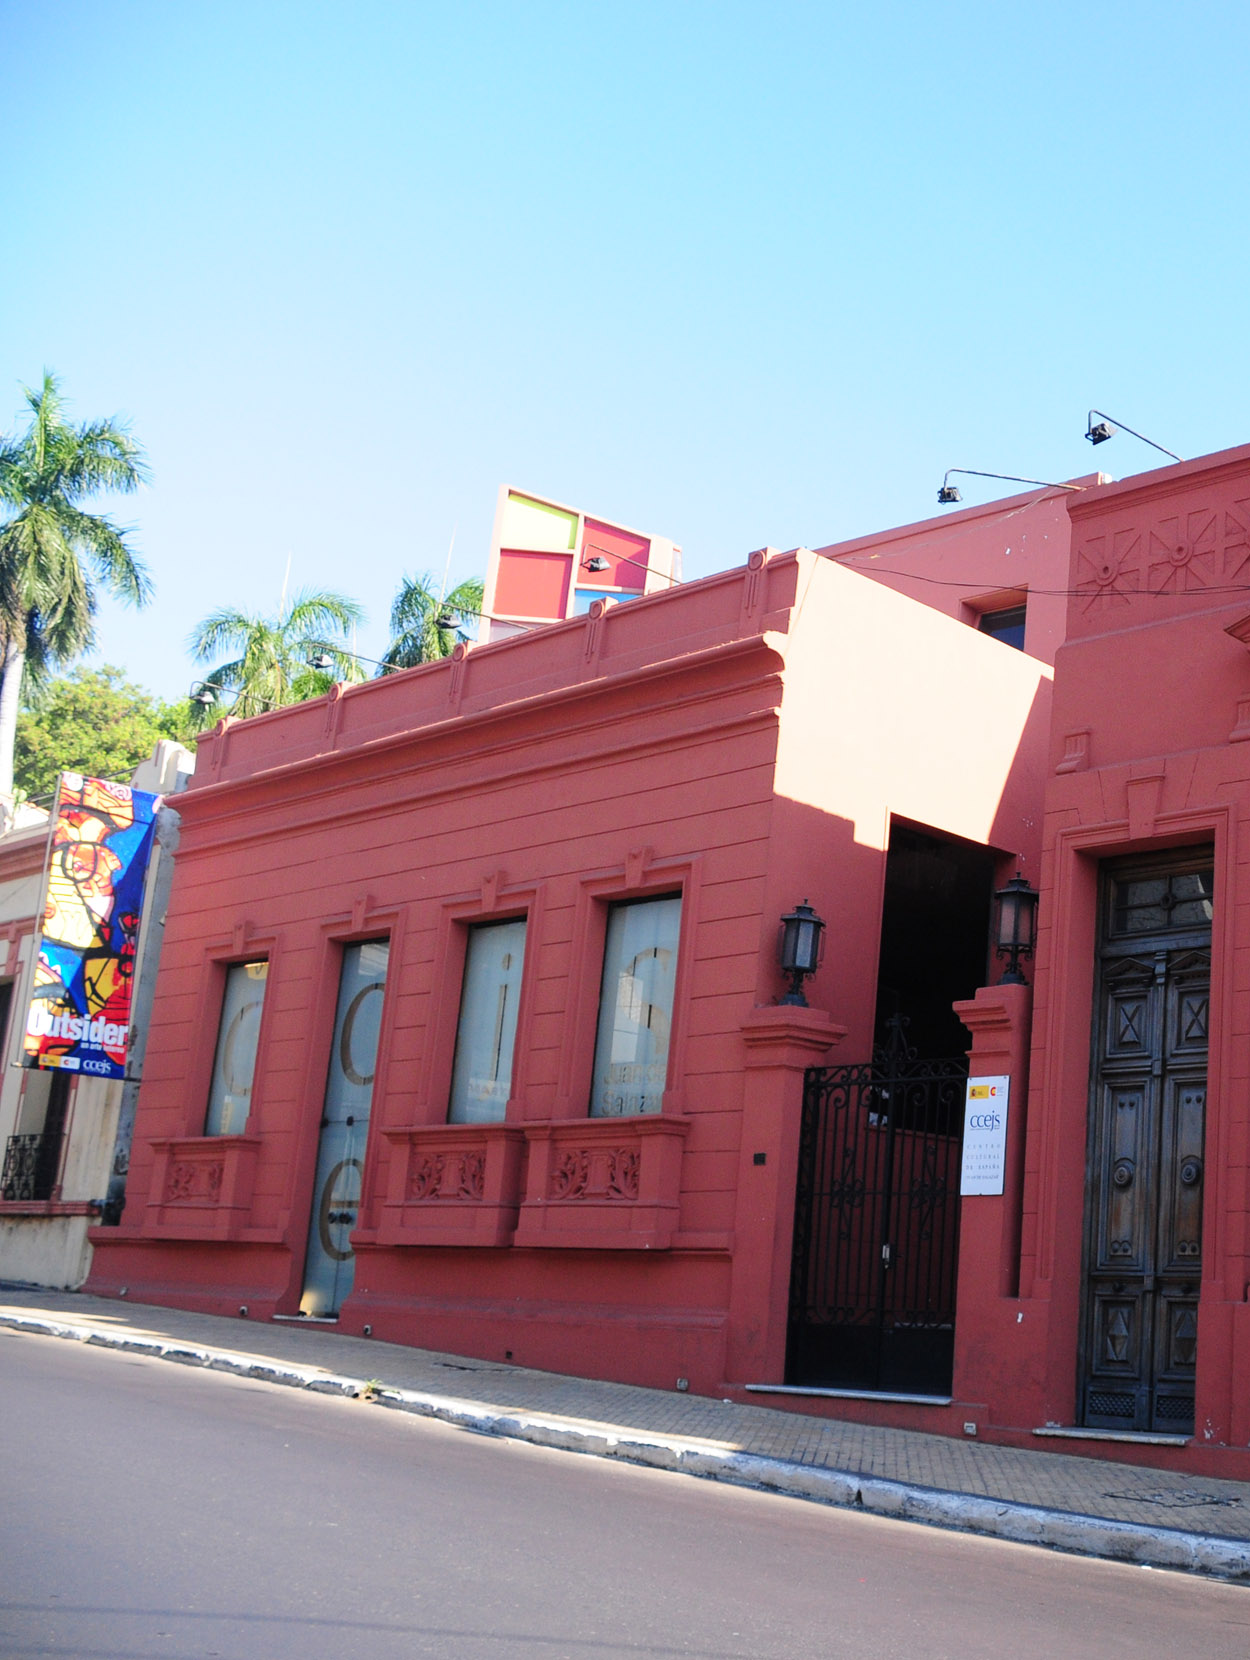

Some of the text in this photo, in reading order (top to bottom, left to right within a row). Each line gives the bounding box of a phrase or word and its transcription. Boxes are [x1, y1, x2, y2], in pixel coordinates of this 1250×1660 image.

[27, 1003, 129, 1046] Outsider
[83, 1059, 111, 1074] ccejs
[970, 1110, 1000, 1131] ccejs
